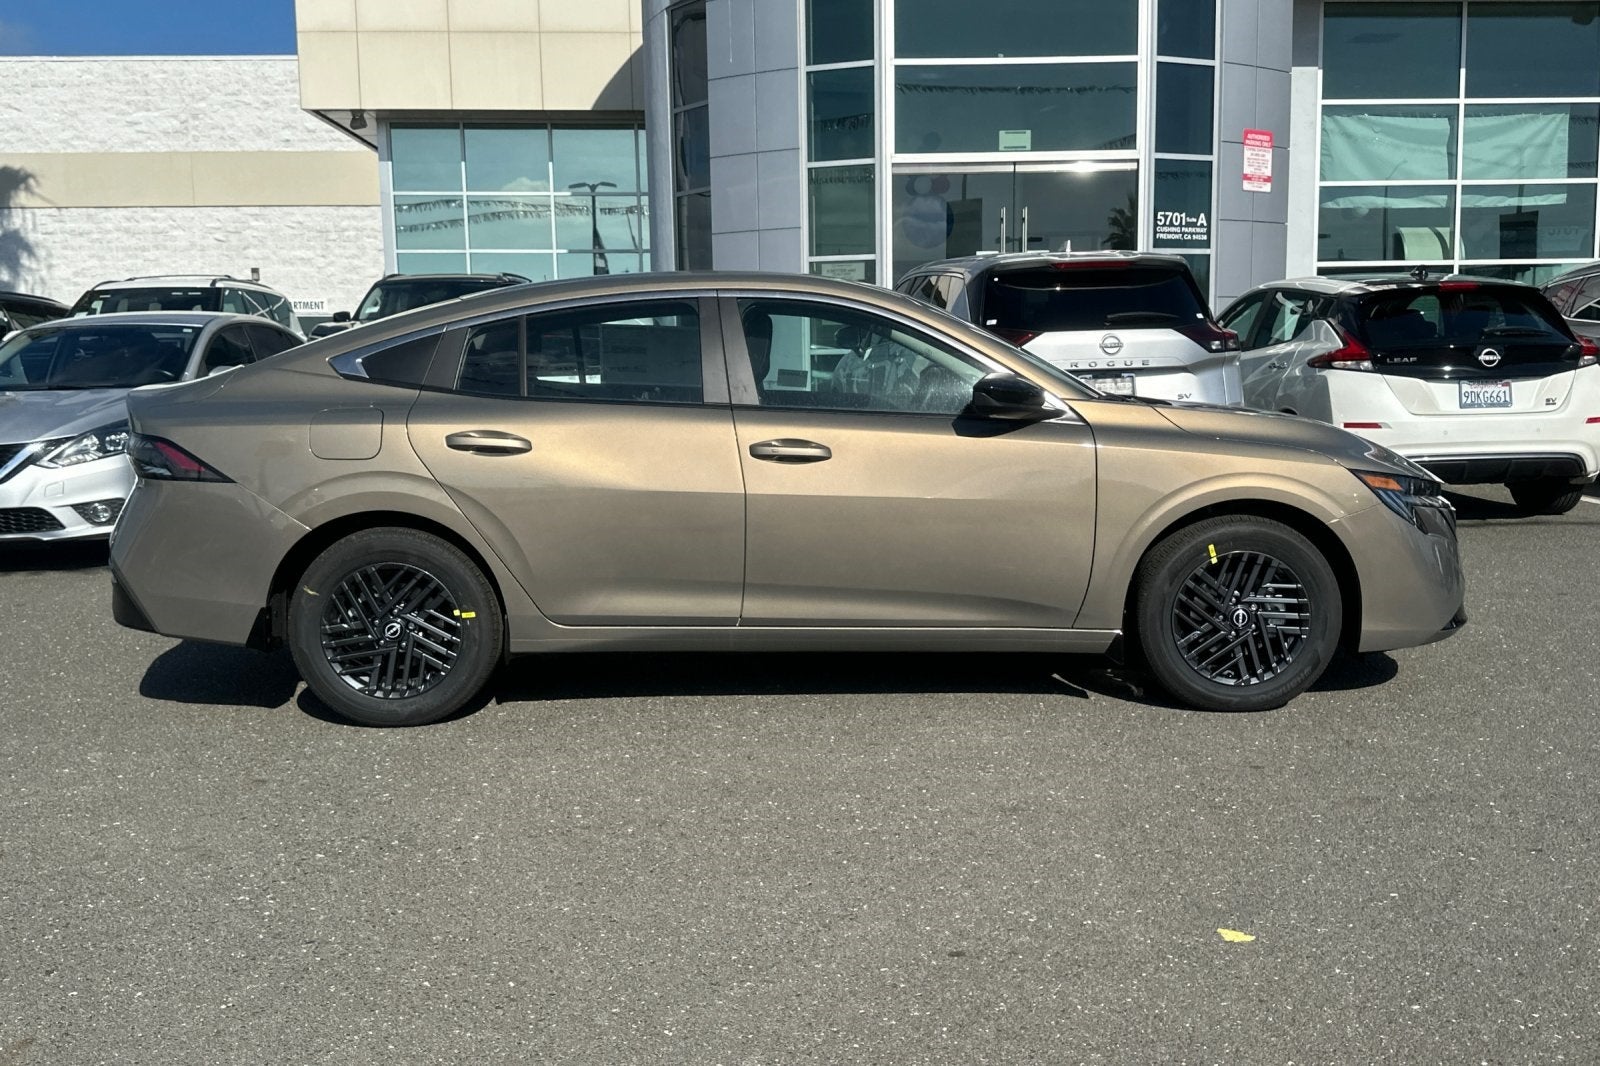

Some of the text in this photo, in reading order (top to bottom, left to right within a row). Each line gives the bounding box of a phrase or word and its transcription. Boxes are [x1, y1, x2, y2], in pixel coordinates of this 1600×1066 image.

[1156, 211, 1186, 225] 5701
[1197, 213, 1207, 226] A
[1070, 360, 1150, 368] ROGUE
[1463, 391, 1509, 404] 9DKG661
